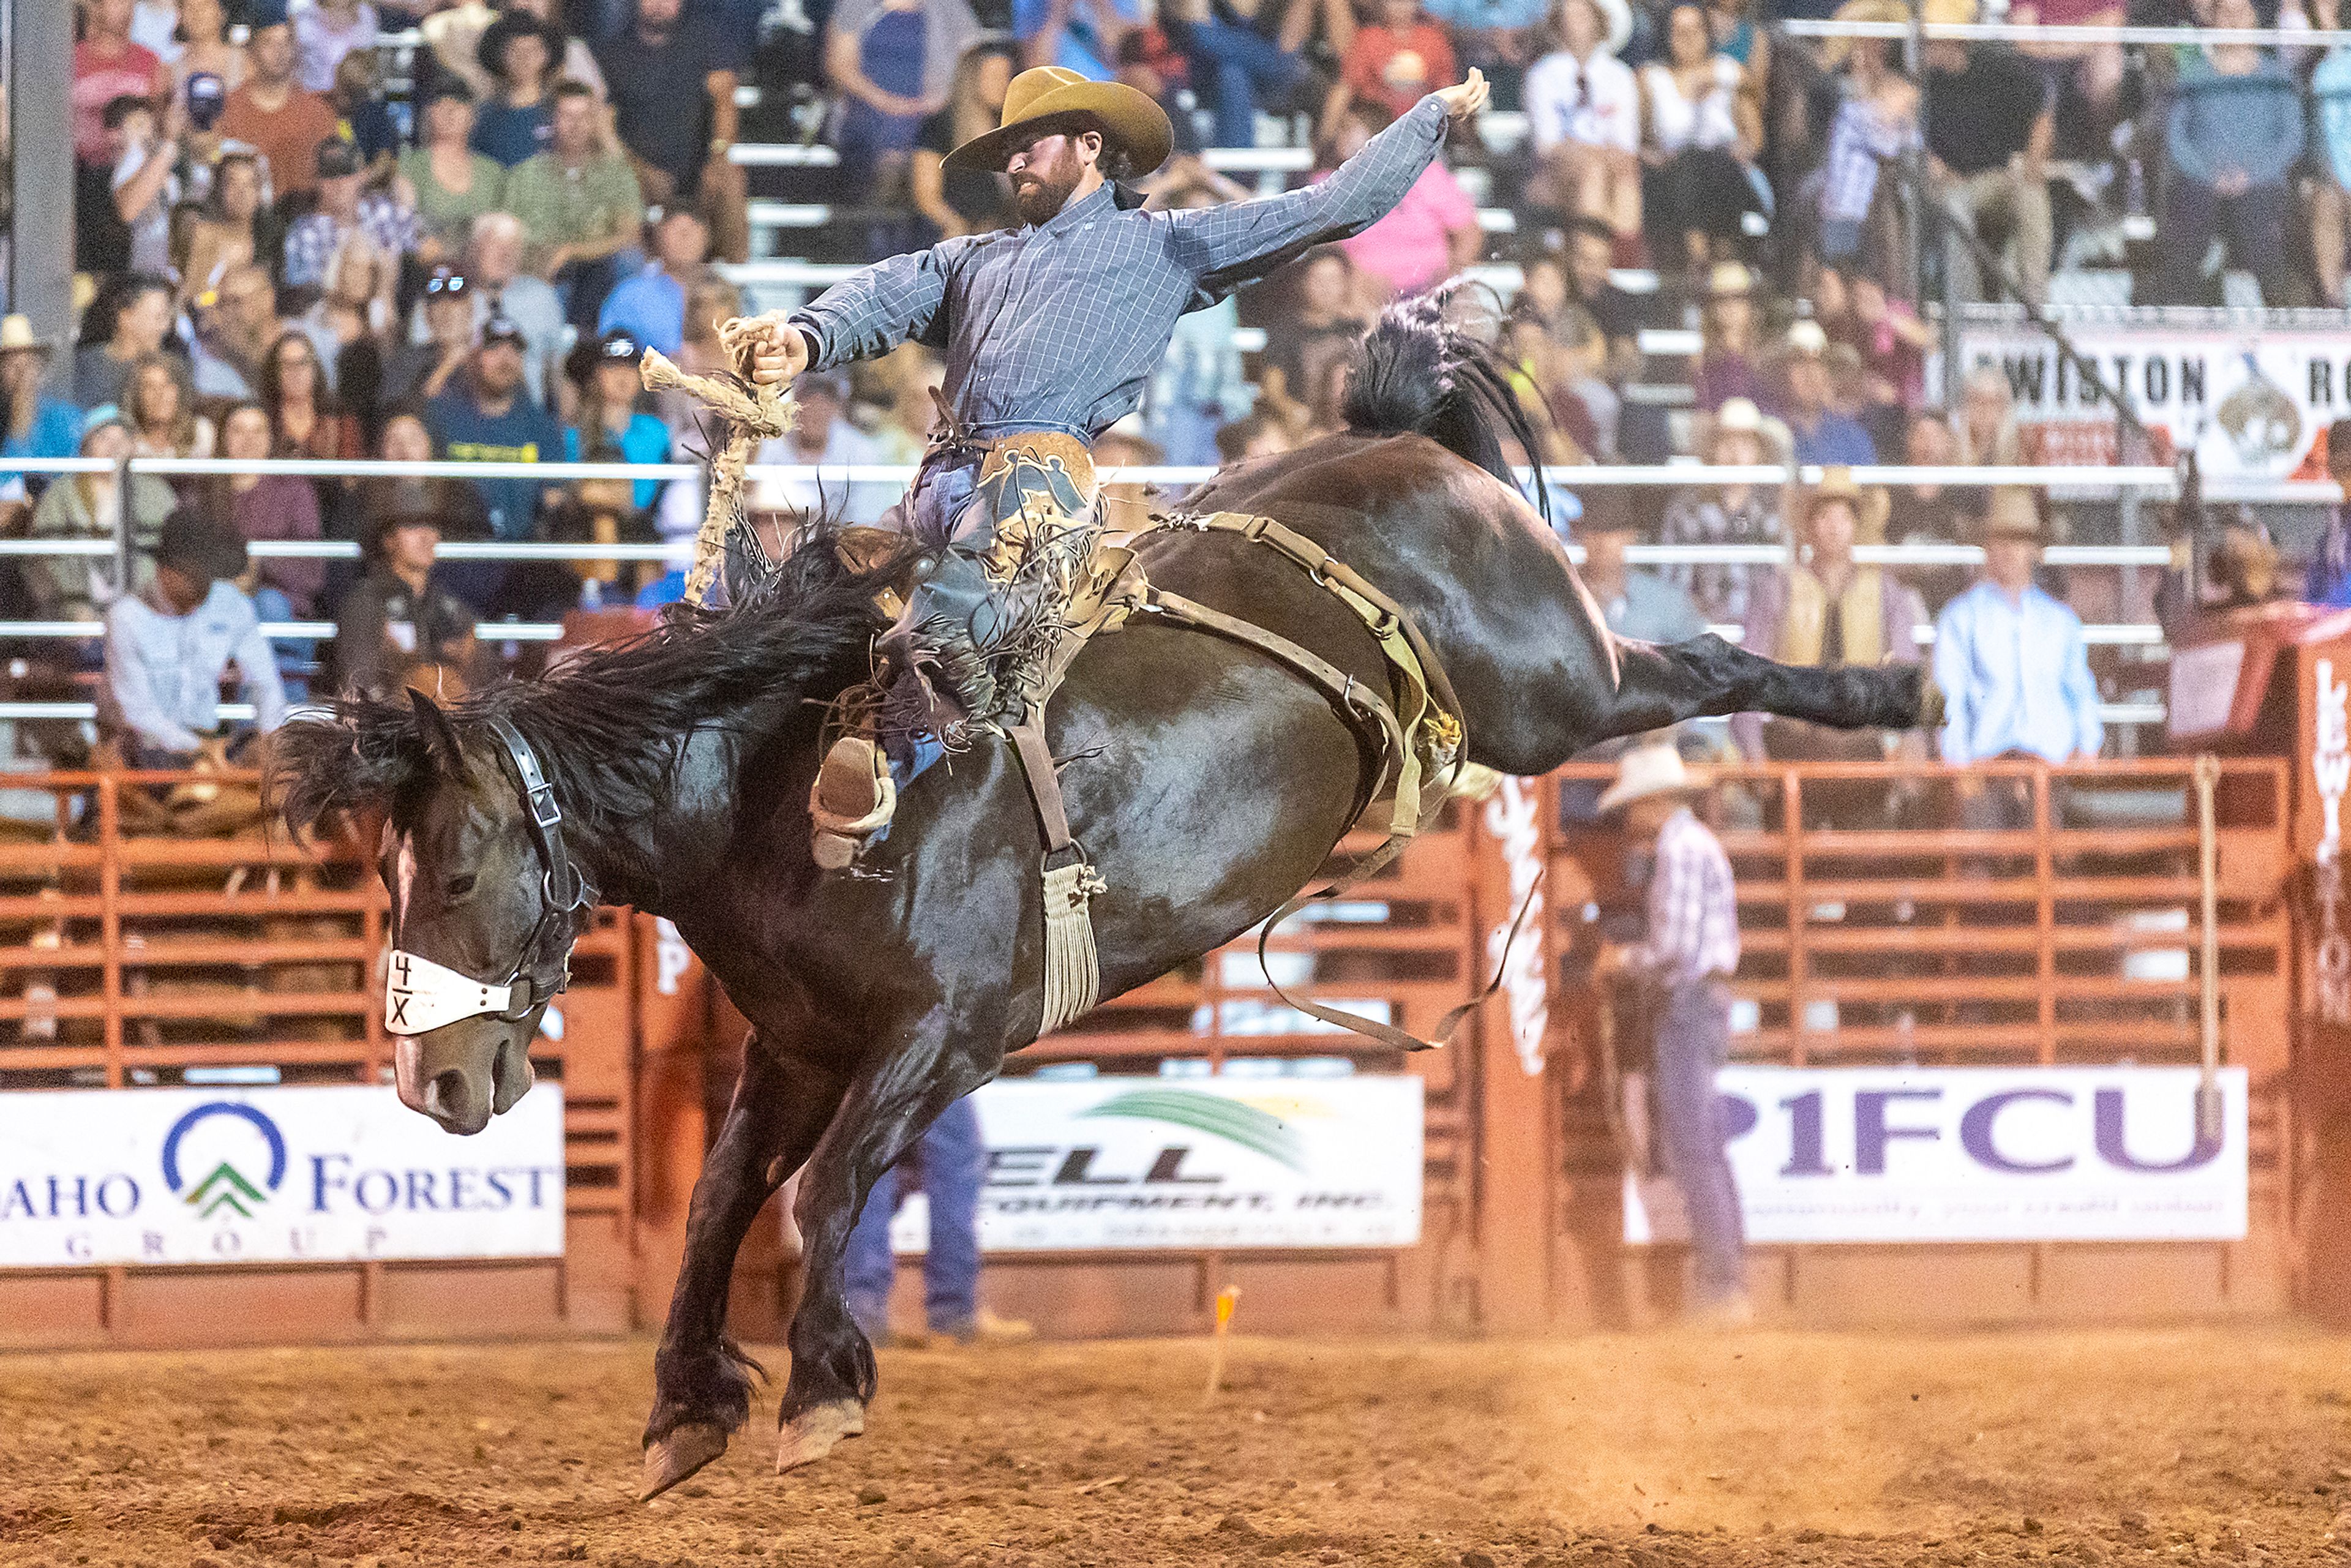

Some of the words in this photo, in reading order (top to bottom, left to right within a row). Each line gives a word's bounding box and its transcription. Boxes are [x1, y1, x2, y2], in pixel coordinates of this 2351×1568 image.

[396, 955, 411, 986] 4
[391, 996, 410, 1026] X
[307, 1152, 558, 1215] FOREST
